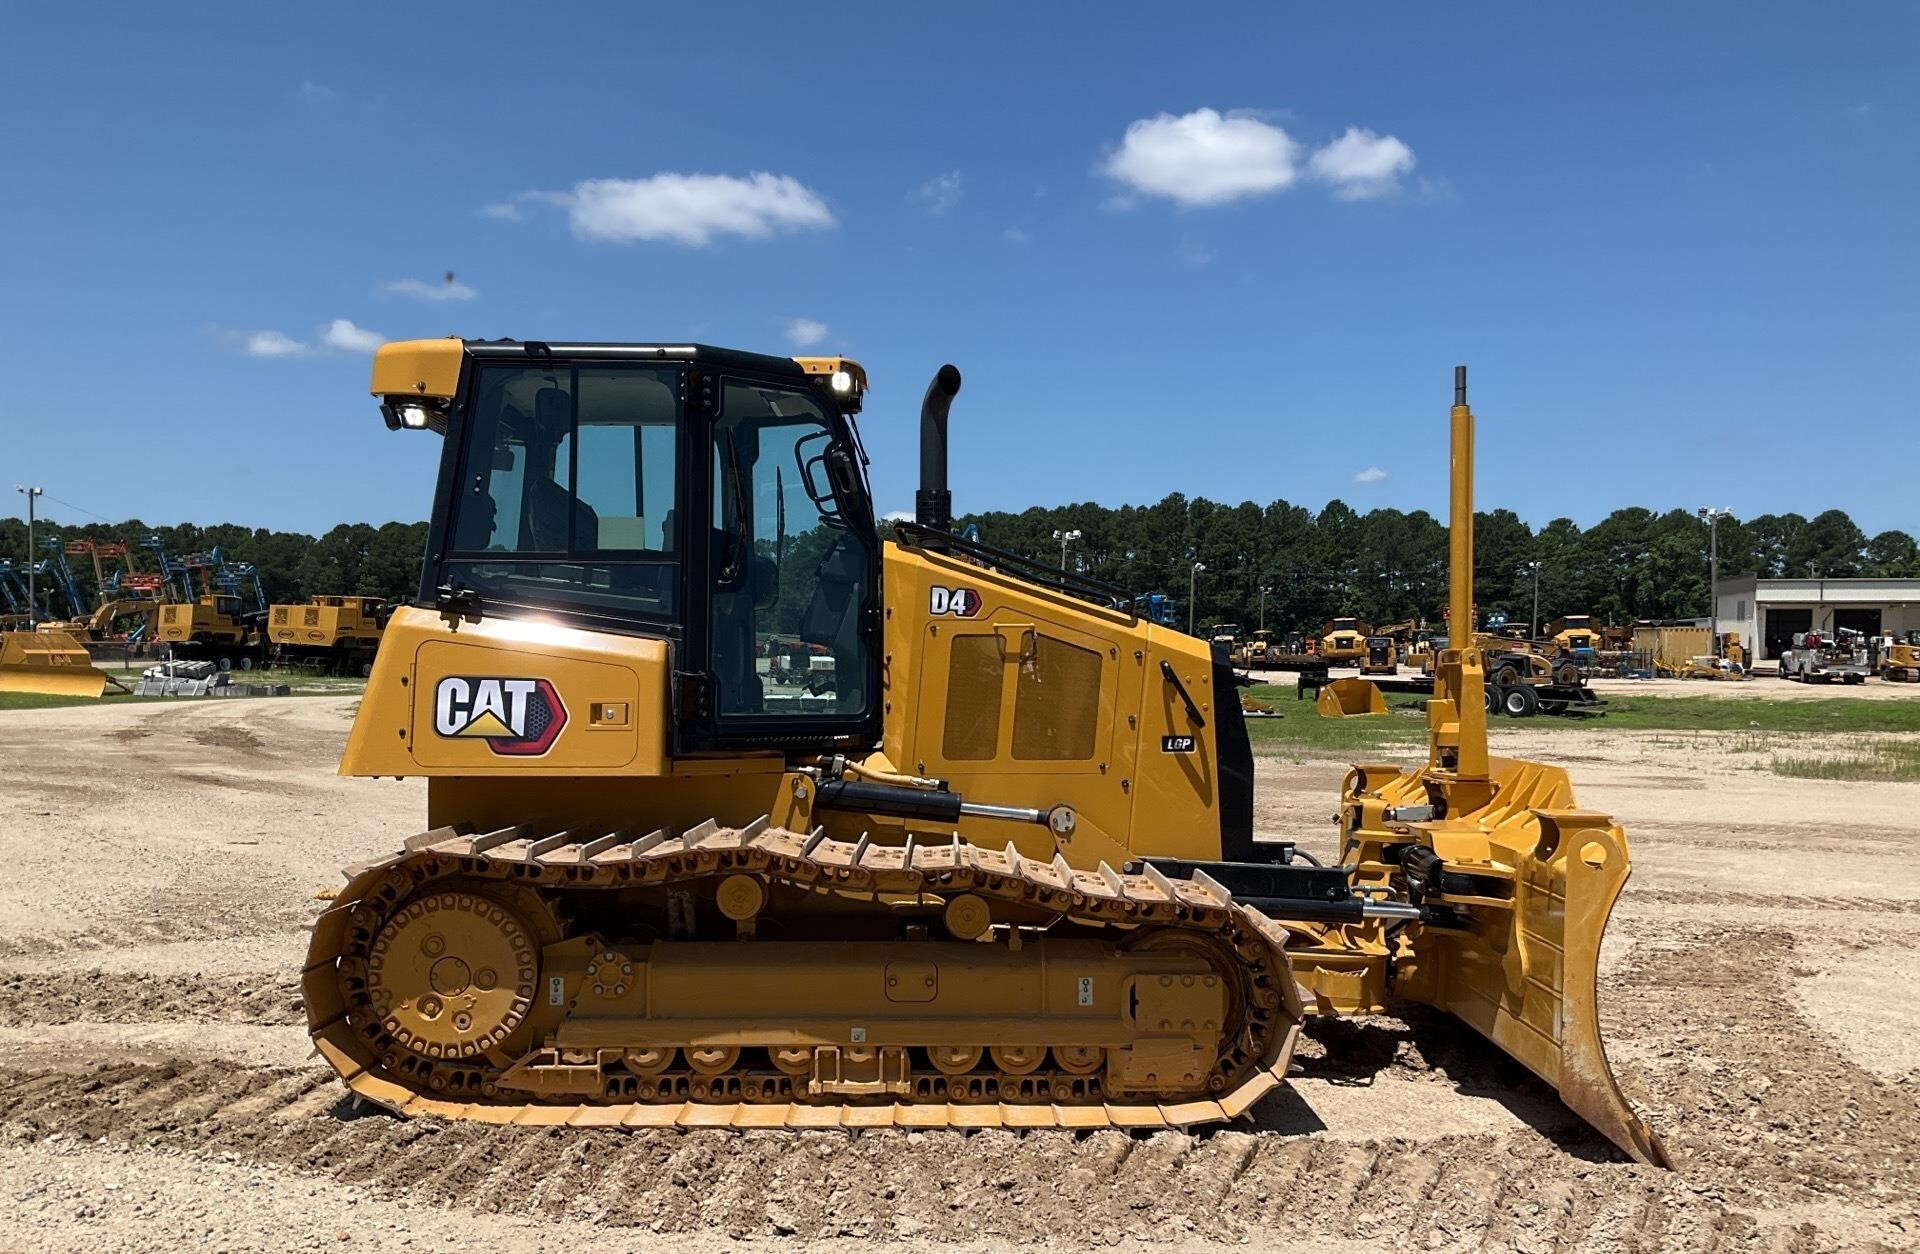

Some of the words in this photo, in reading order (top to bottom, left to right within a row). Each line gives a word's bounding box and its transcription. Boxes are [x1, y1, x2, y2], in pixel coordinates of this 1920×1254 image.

[931, 587, 966, 615] D4
[436, 678, 536, 737] CAT
[1167, 738, 1191, 750] LGP
